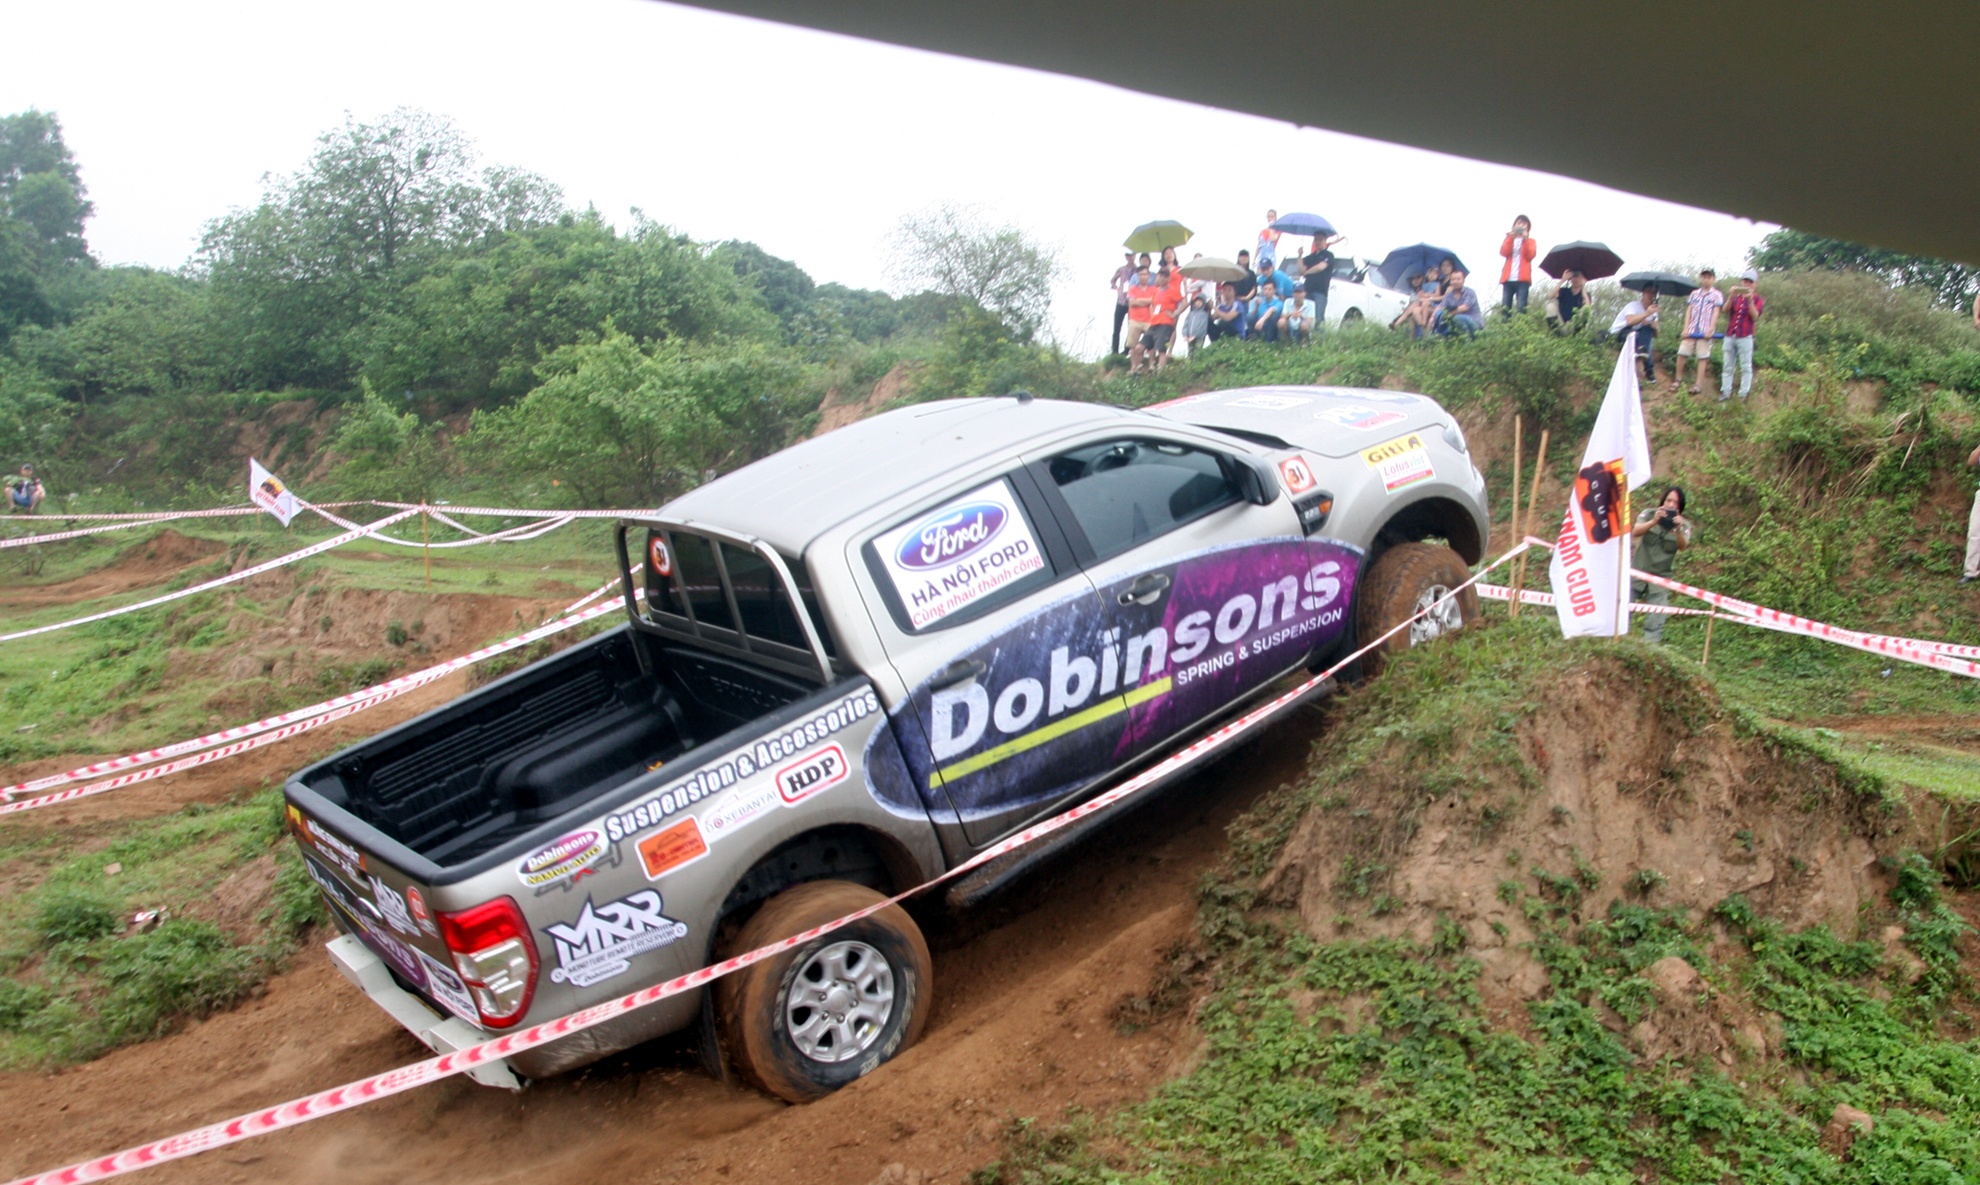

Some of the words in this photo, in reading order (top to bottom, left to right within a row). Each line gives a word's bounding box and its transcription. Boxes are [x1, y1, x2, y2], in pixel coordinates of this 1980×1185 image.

[1287, 463, 1308, 487] 31
[1368, 442, 1404, 463] Giti
[920, 511, 989, 565] Ford
[911, 580, 942, 608] HÀ
[941, 564, 978, 591] NỘI
[979, 539, 1030, 575] FORD
[913, 604, 946, 626] Cùng
[947, 588, 976, 611] nhau
[977, 570, 1012, 594] thành
[1013, 554, 1043, 577] công
[1566, 567, 1596, 617] CLUB
[930, 560, 1343, 764] Dobinsons
[1177, 646, 1235, 686] SPRING
[1238, 645, 1250, 661] &
[1252, 607, 1343, 655] SUSPENSION
[605, 763, 736, 841] Suspension
[737, 754, 755, 778] &
[754, 689, 879, 770] Accessories
[786, 756, 836, 794] HDP
[526, 831, 595, 868] Dobinsons
[546, 889, 676, 967] MRR
